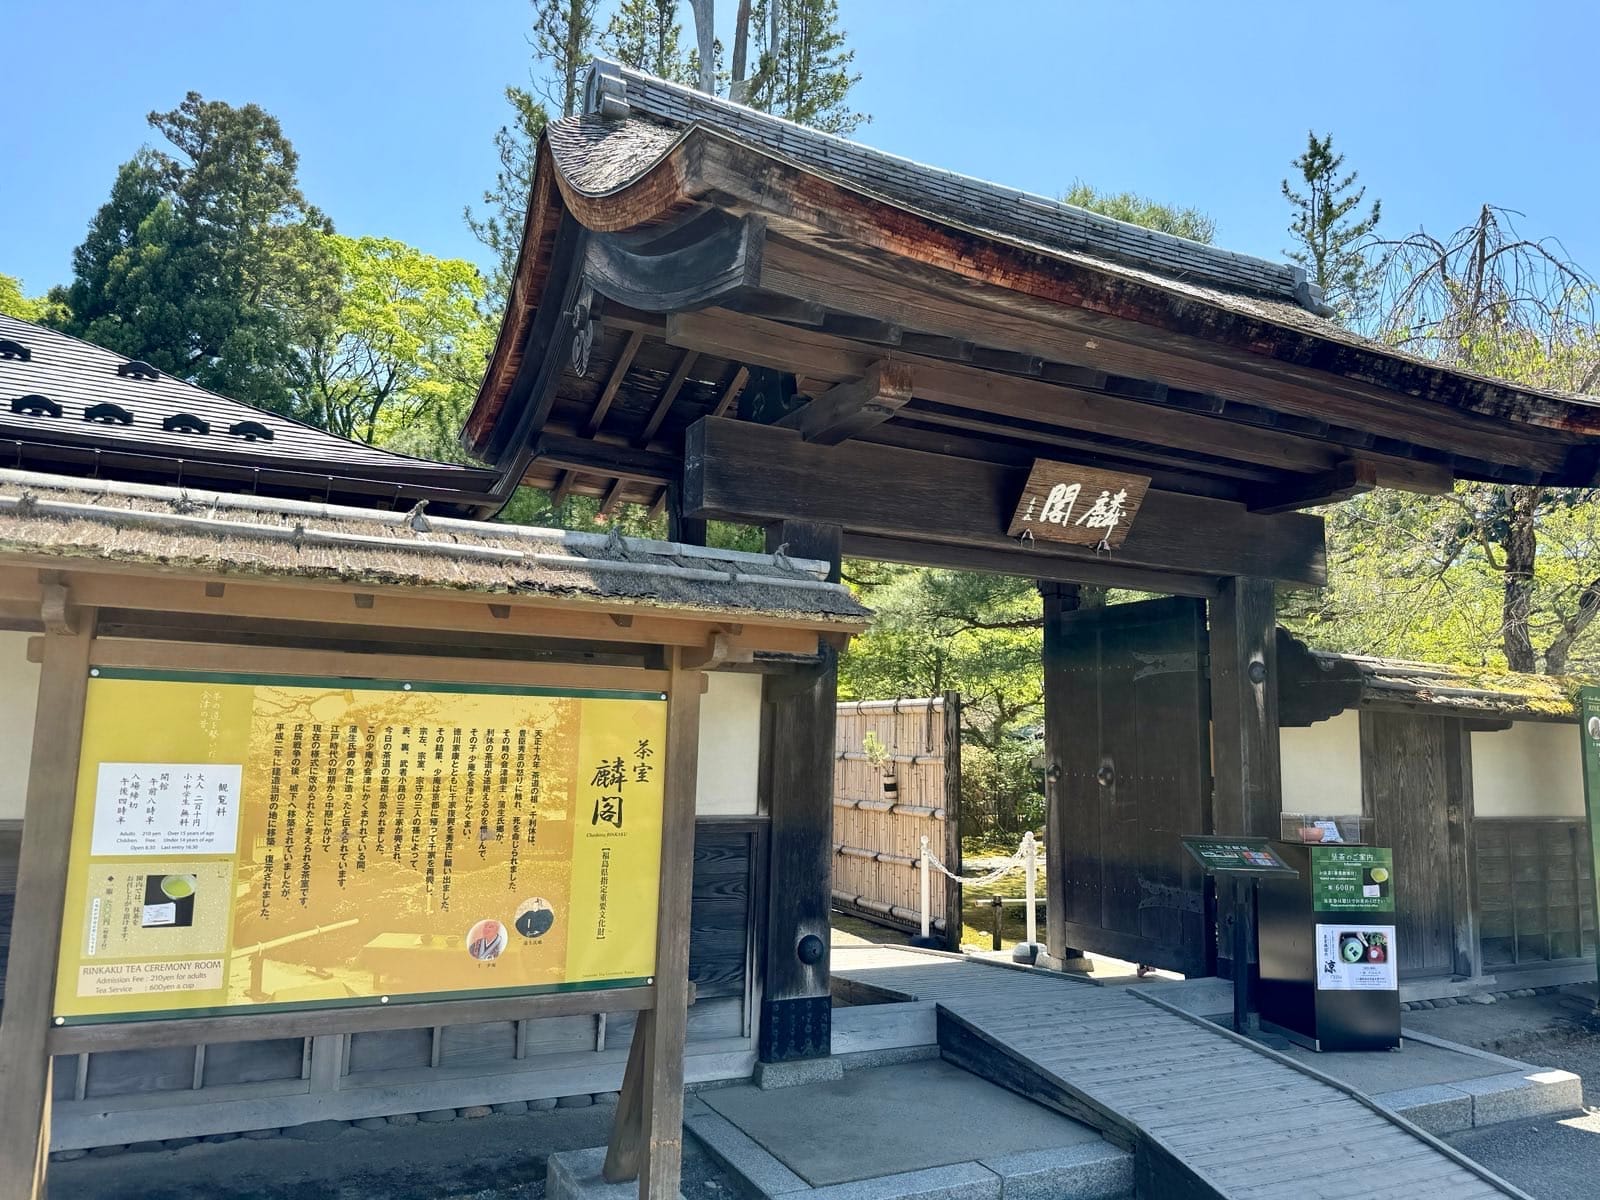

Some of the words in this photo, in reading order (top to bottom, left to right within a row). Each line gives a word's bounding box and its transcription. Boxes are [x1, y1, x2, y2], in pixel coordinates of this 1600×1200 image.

[633, 740, 654, 784] 茶室
[116, 778, 129, 825] 午後四時半
[145, 778, 158, 825] 午前八時半
[216, 783, 229, 817] 観覧料
[590, 756, 628, 828] 麟閣
[1335, 884, 1355, 892] 600円
[83, 967, 122, 976] RINKAKU
[126, 965, 142, 973] TEA
[144, 963, 193, 973] CEREMONY
[194, 961, 221, 969] ROOM
[96, 977, 131, 985] Admission
[151, 974, 174, 982] 210yen
[177, 973, 186, 981] for
[187, 972, 207, 980] adults
[96, 986, 107, 994] Tea
[108, 985, 133, 994] Service
[149, 983, 175, 991] 600yen
